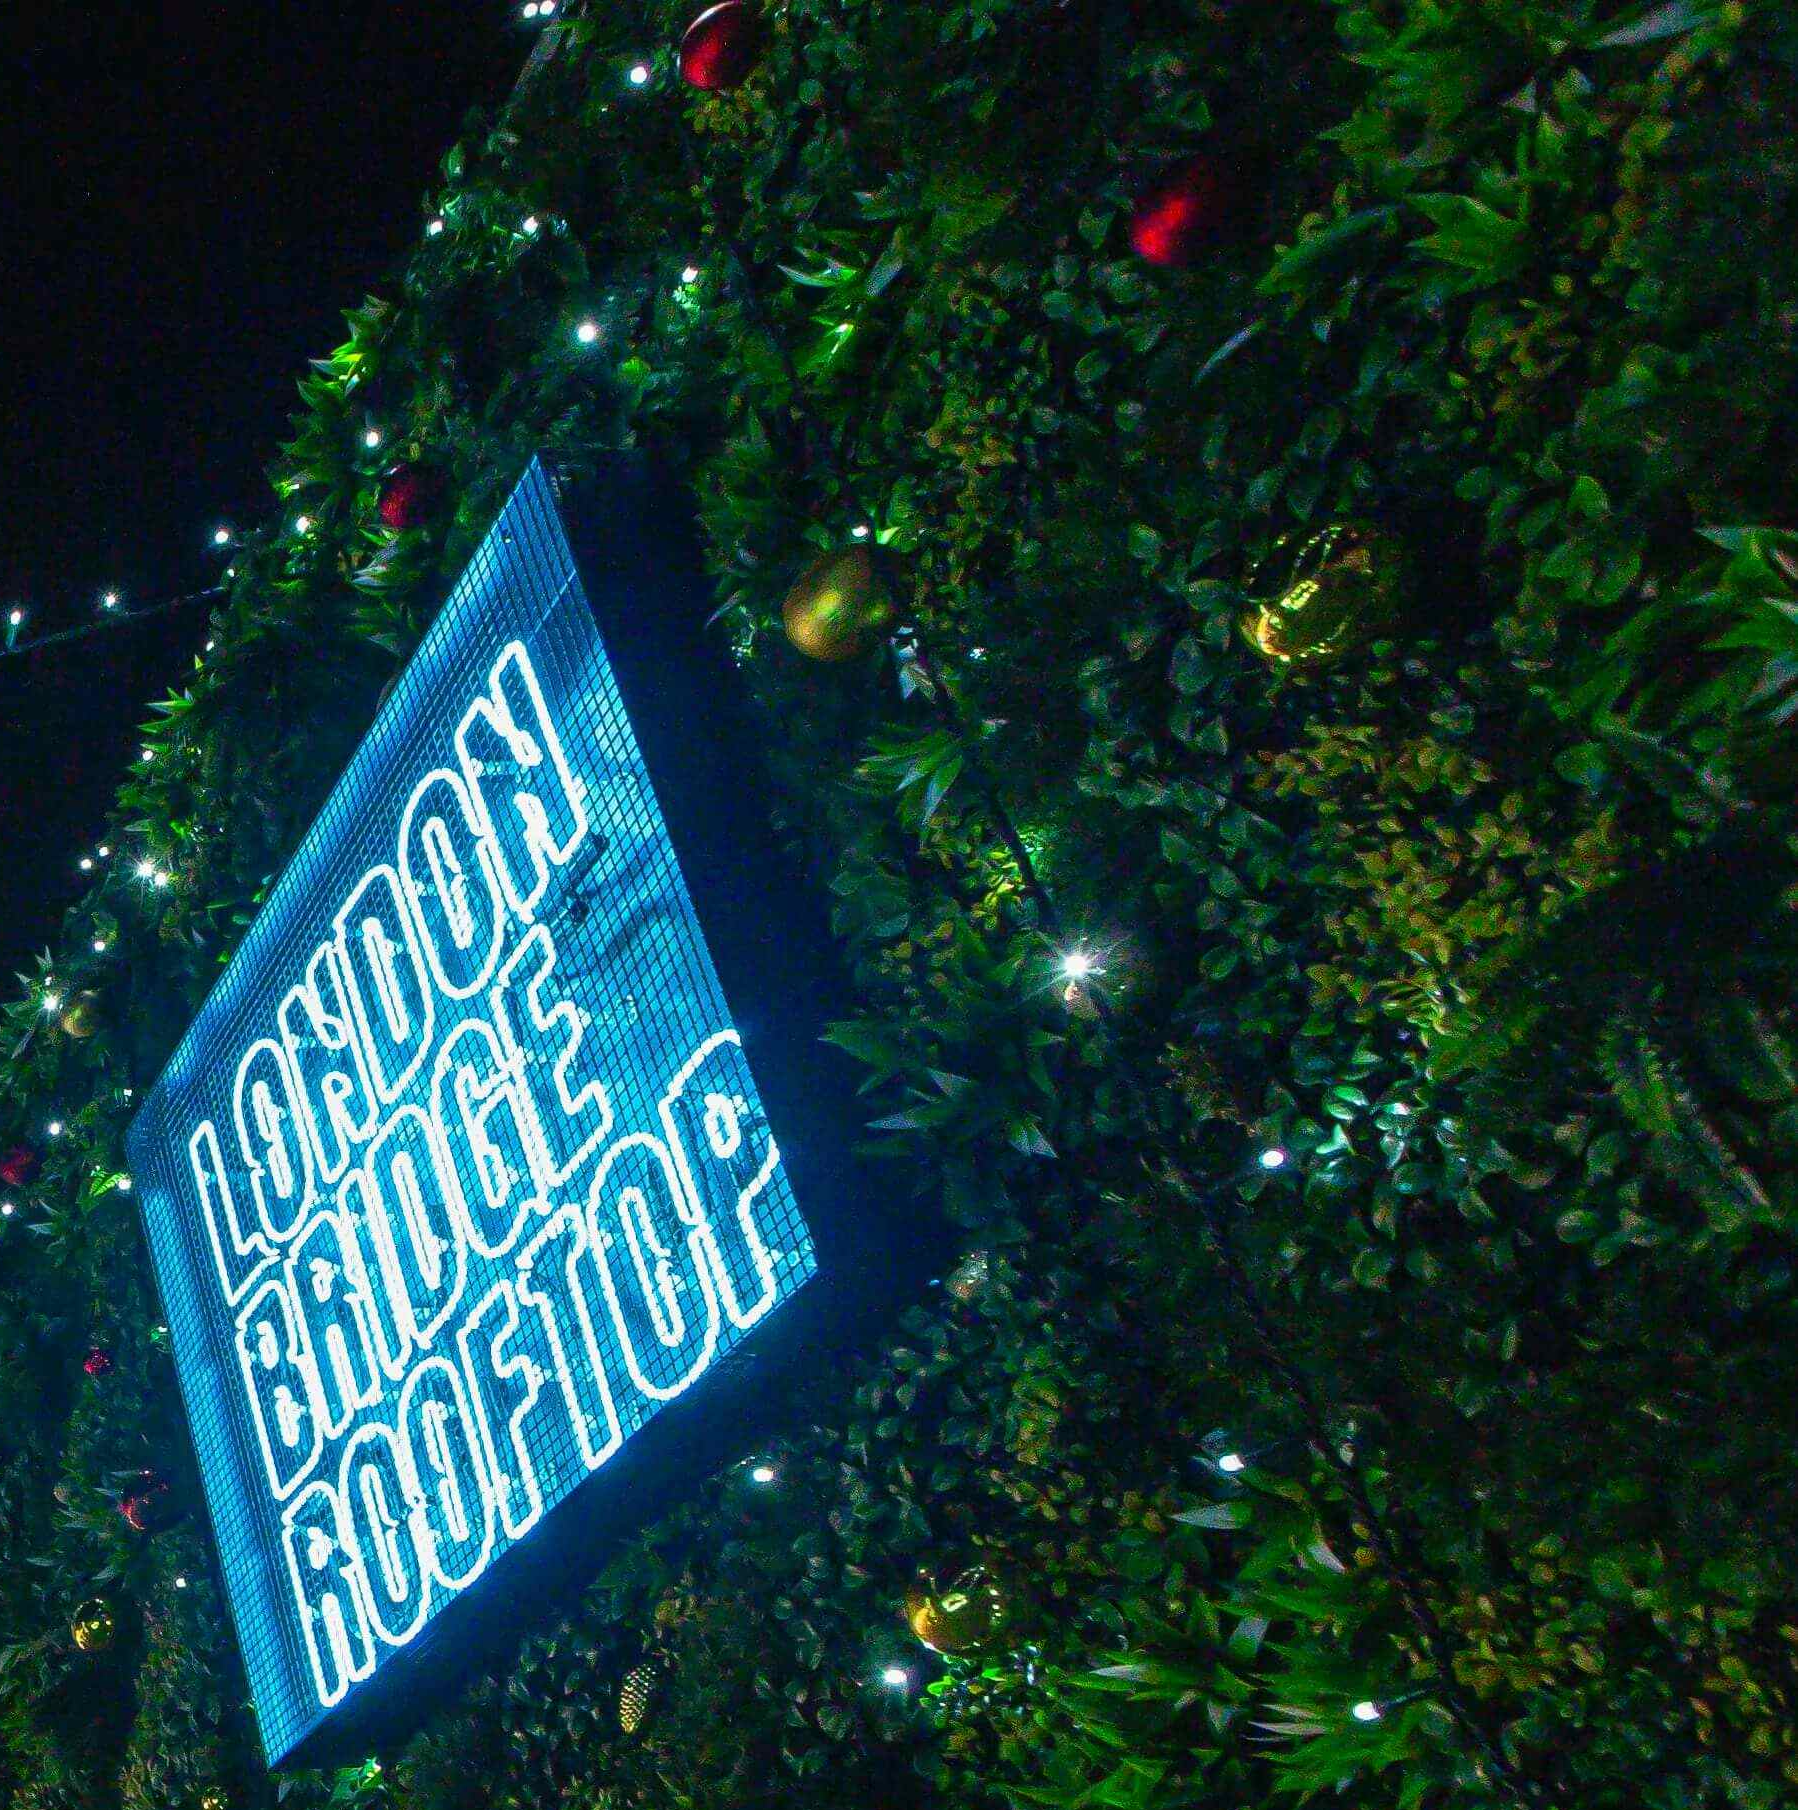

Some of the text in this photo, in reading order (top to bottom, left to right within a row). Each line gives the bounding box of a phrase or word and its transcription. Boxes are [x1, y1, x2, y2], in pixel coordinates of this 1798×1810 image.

[188, 641, 589, 1307] LONDON
[235, 923, 613, 1501] BRIDGE
[283, 1029, 781, 1708] ROOFTOP
